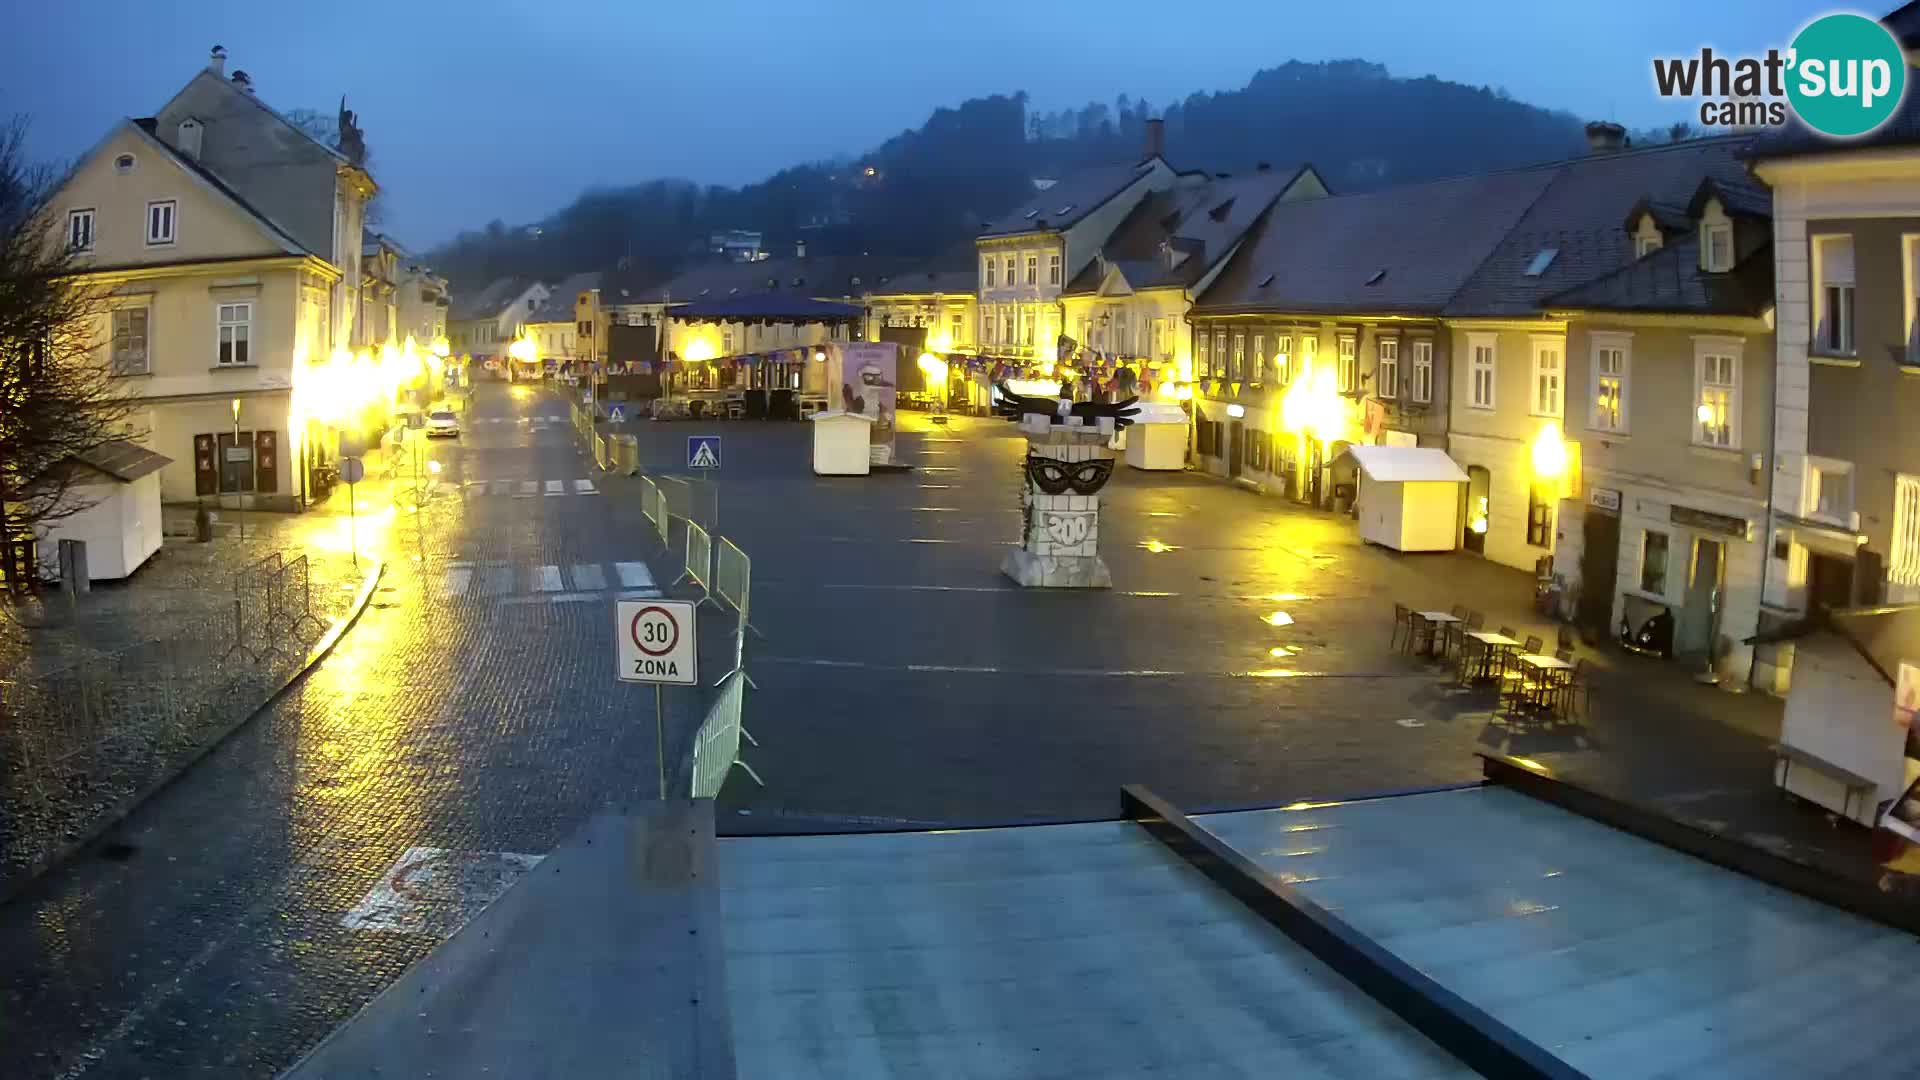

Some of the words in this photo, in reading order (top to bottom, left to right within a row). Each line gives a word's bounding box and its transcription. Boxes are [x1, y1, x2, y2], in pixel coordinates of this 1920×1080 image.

[1048, 516, 1087, 546] 200
[643, 622, 668, 643] 30
[634, 659, 679, 676] ZONA
